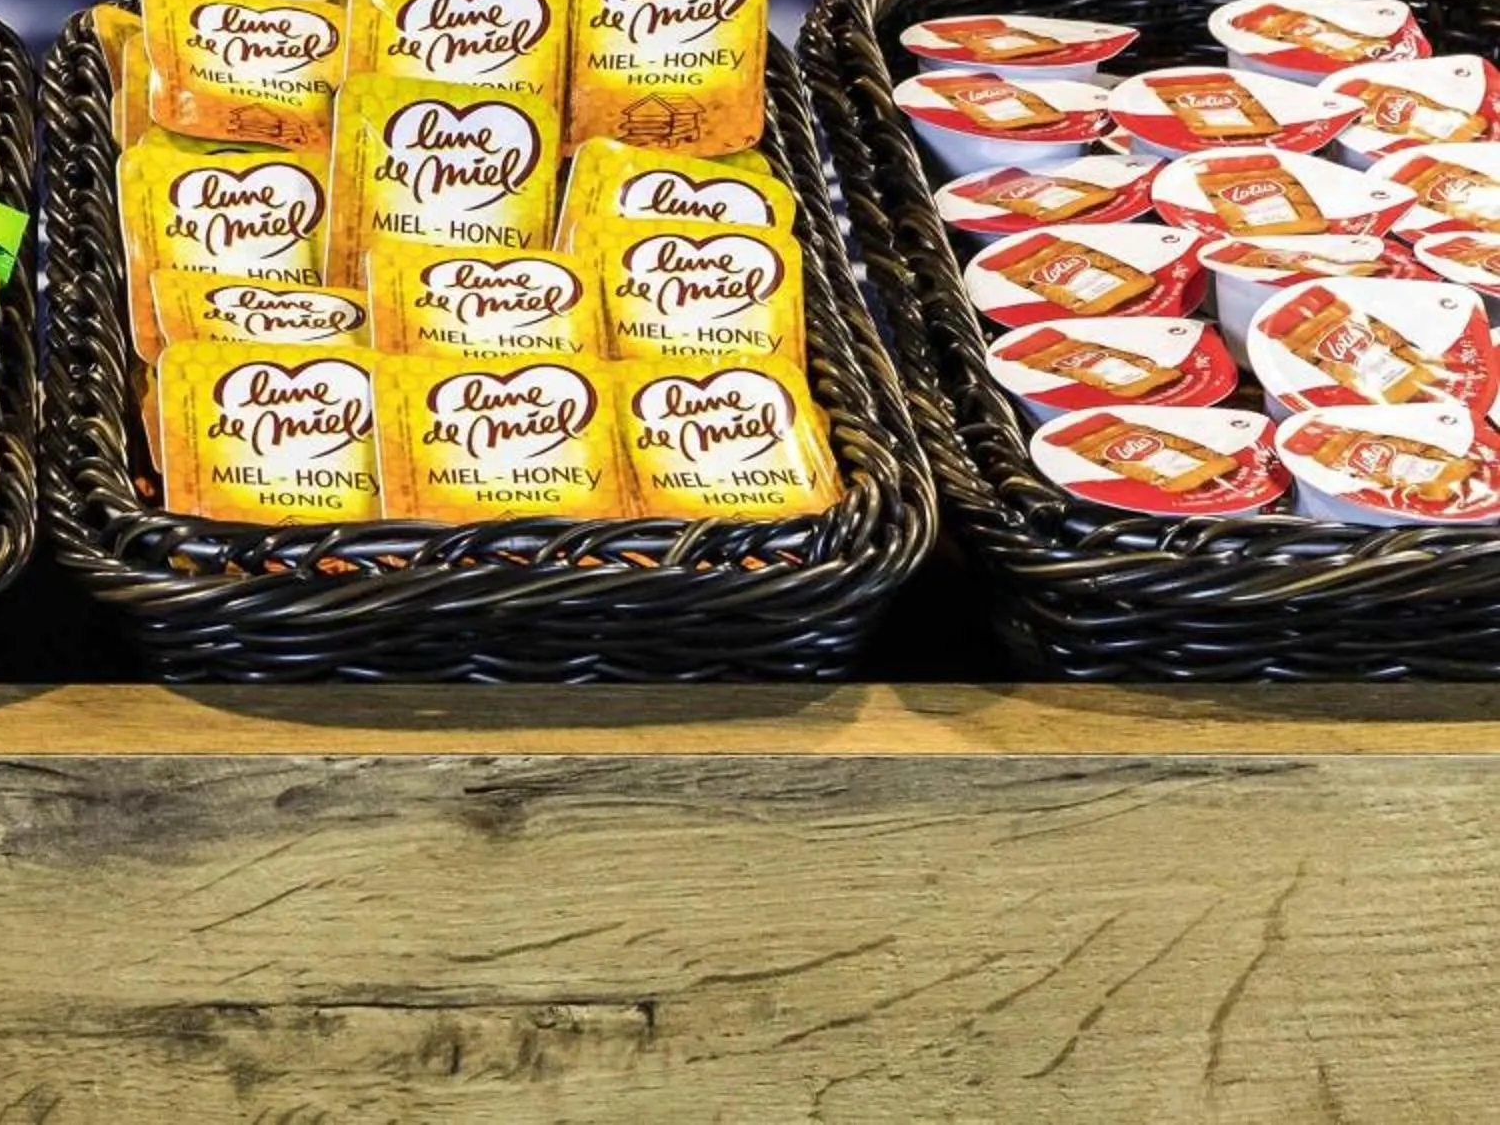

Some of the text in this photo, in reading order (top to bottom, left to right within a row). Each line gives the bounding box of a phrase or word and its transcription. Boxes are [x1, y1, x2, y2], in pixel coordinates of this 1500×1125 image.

[213, 8, 300, 34] lune
[590, 9, 625, 31] de
[187, 35, 328, 68] de miel
[388, 19, 530, 72] de miel
[587, 53, 640, 70] MIEL
[664, 49, 746, 69] HONEY
[190, 64, 235, 84] MIEL
[262, 77, 340, 97] HONEY
[627, 72, 703, 85] HONIG
[230, 87, 303, 106] HONIG
[406, 110, 503, 150] lune
[375, 148, 525, 204] de miel
[194, 175, 286, 210] lune
[638, 179, 729, 222] lune
[166, 201, 313, 256] de miel
[373, 211, 426, 236] MIEL
[450, 221, 533, 248] HONEY
[646, 241, 747, 274] lune
[445, 264, 542, 290] lune
[616, 267, 765, 315] de miel
[204, 309, 237, 323] de
[231, 290, 324, 313] lune
[415, 287, 562, 326] de miel
[419, 327, 467, 344] MIEL
[499, 334, 584, 353] HONEY
[617, 321, 673, 340] MIEL
[698, 328, 783, 352] HONEY
[239, 371, 342, 407] lune
[453, 379, 554, 411] lune
[658, 385, 756, 420] lune
[208, 399, 367, 457] de miel
[423, 398, 580, 459] de miel
[637, 403, 783, 463] de miel
[212, 466, 271, 486] MIEL
[296, 469, 381, 497] HONEY
[429, 468, 487, 485] MIEL
[513, 466, 603, 491] HONEY
[651, 474, 703, 490] MIEL
[733, 471, 817, 491] HONEY
[259, 492, 343, 509] HONIG
[476, 490, 561, 503] HONIG
[703, 492, 786, 505] HONIG
